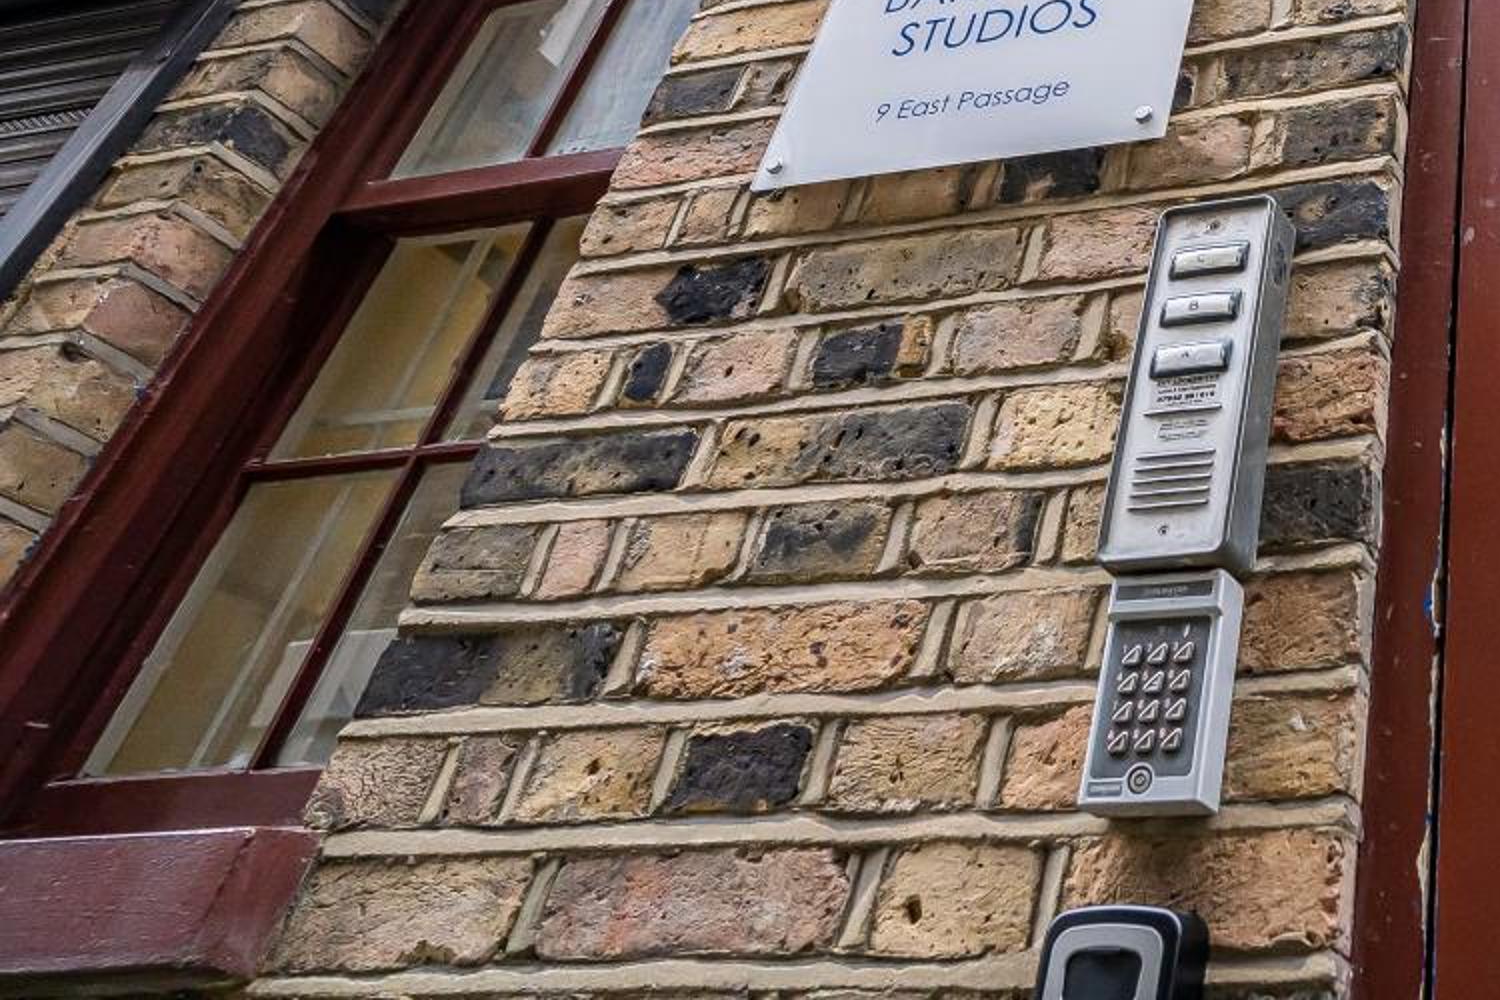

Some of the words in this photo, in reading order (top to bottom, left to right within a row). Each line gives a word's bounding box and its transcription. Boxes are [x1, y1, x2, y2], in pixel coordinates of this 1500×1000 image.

[874, 102, 892, 123] 9
[897, 94, 951, 120] East
[957, 79, 1070, 112] Passage
